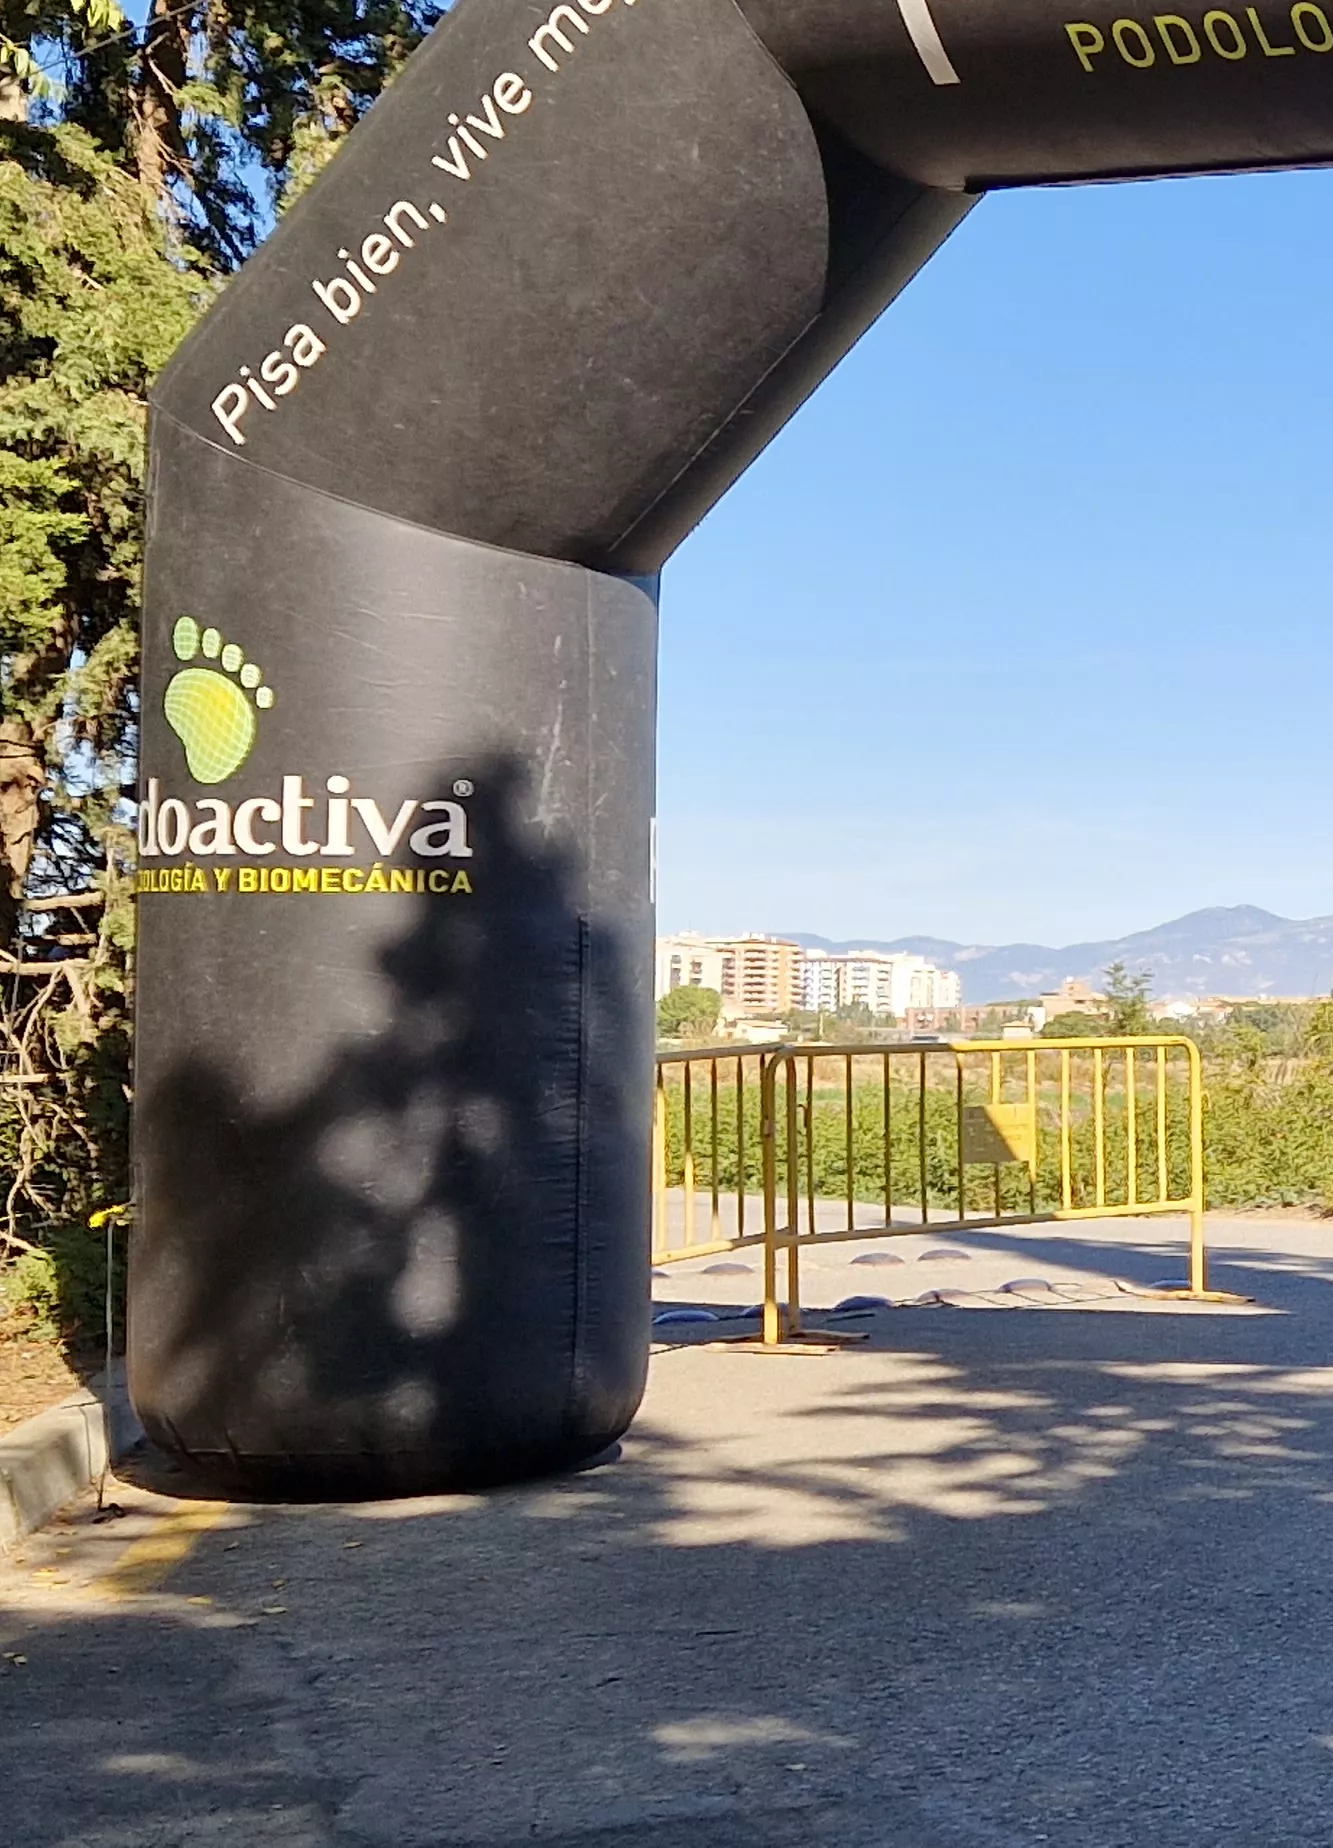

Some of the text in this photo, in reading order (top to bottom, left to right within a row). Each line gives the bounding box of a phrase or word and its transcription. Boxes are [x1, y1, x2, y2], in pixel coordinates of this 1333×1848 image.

[211, 72, 532, 446] Pisa bien, vive
[213, 867, 233, 893] Y
[239, 861, 474, 893] BIOMECÁNICA
